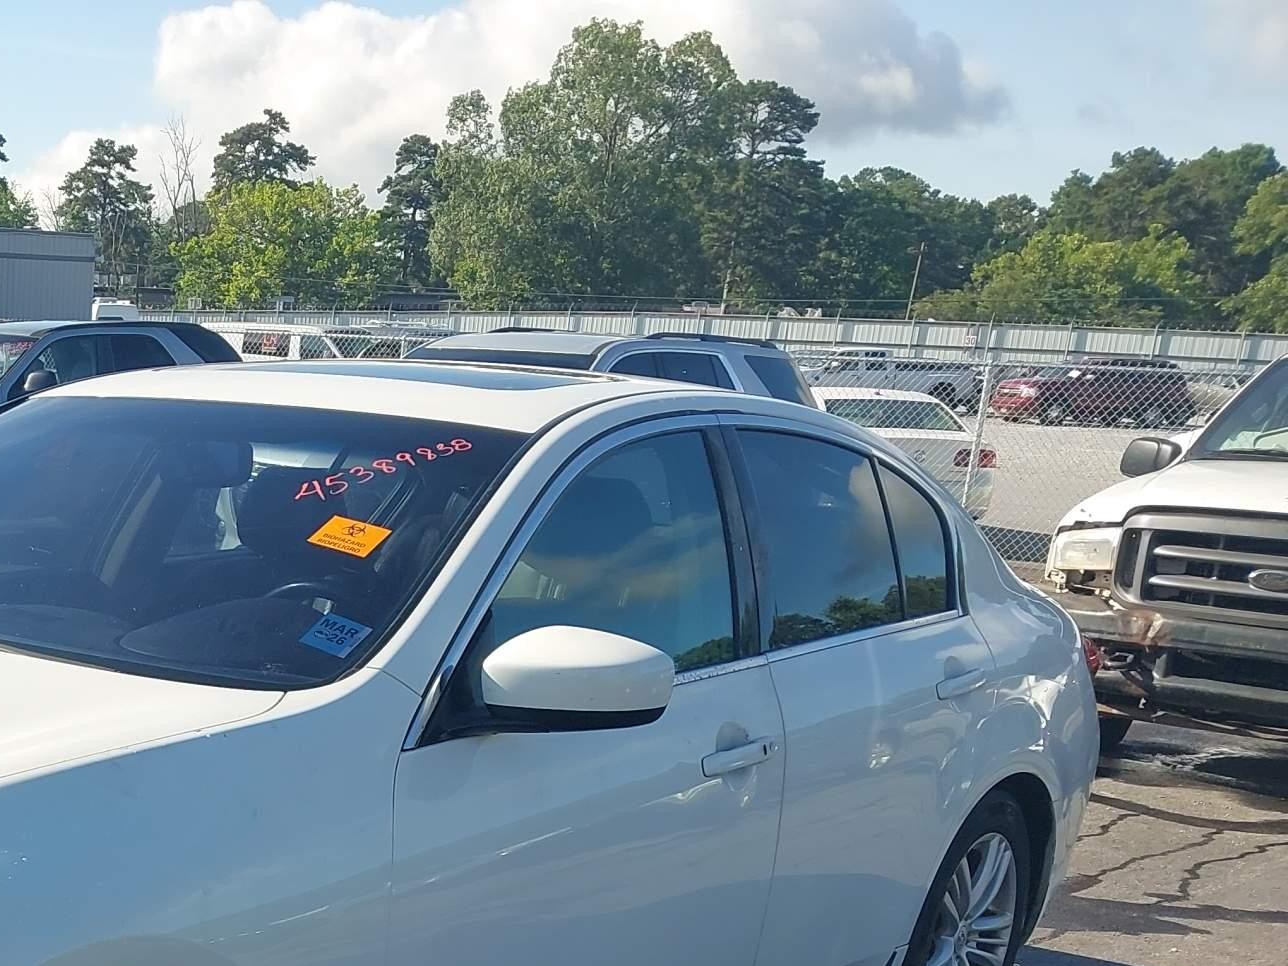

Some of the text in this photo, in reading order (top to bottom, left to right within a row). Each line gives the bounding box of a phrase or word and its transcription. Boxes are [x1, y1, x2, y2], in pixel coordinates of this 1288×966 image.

[294, 438, 473, 501] 45389838
[317, 538, 361, 553] BIOPELIGRO
[320, 618, 359, 638] MAR
[326, 633, 347, 645] 26
